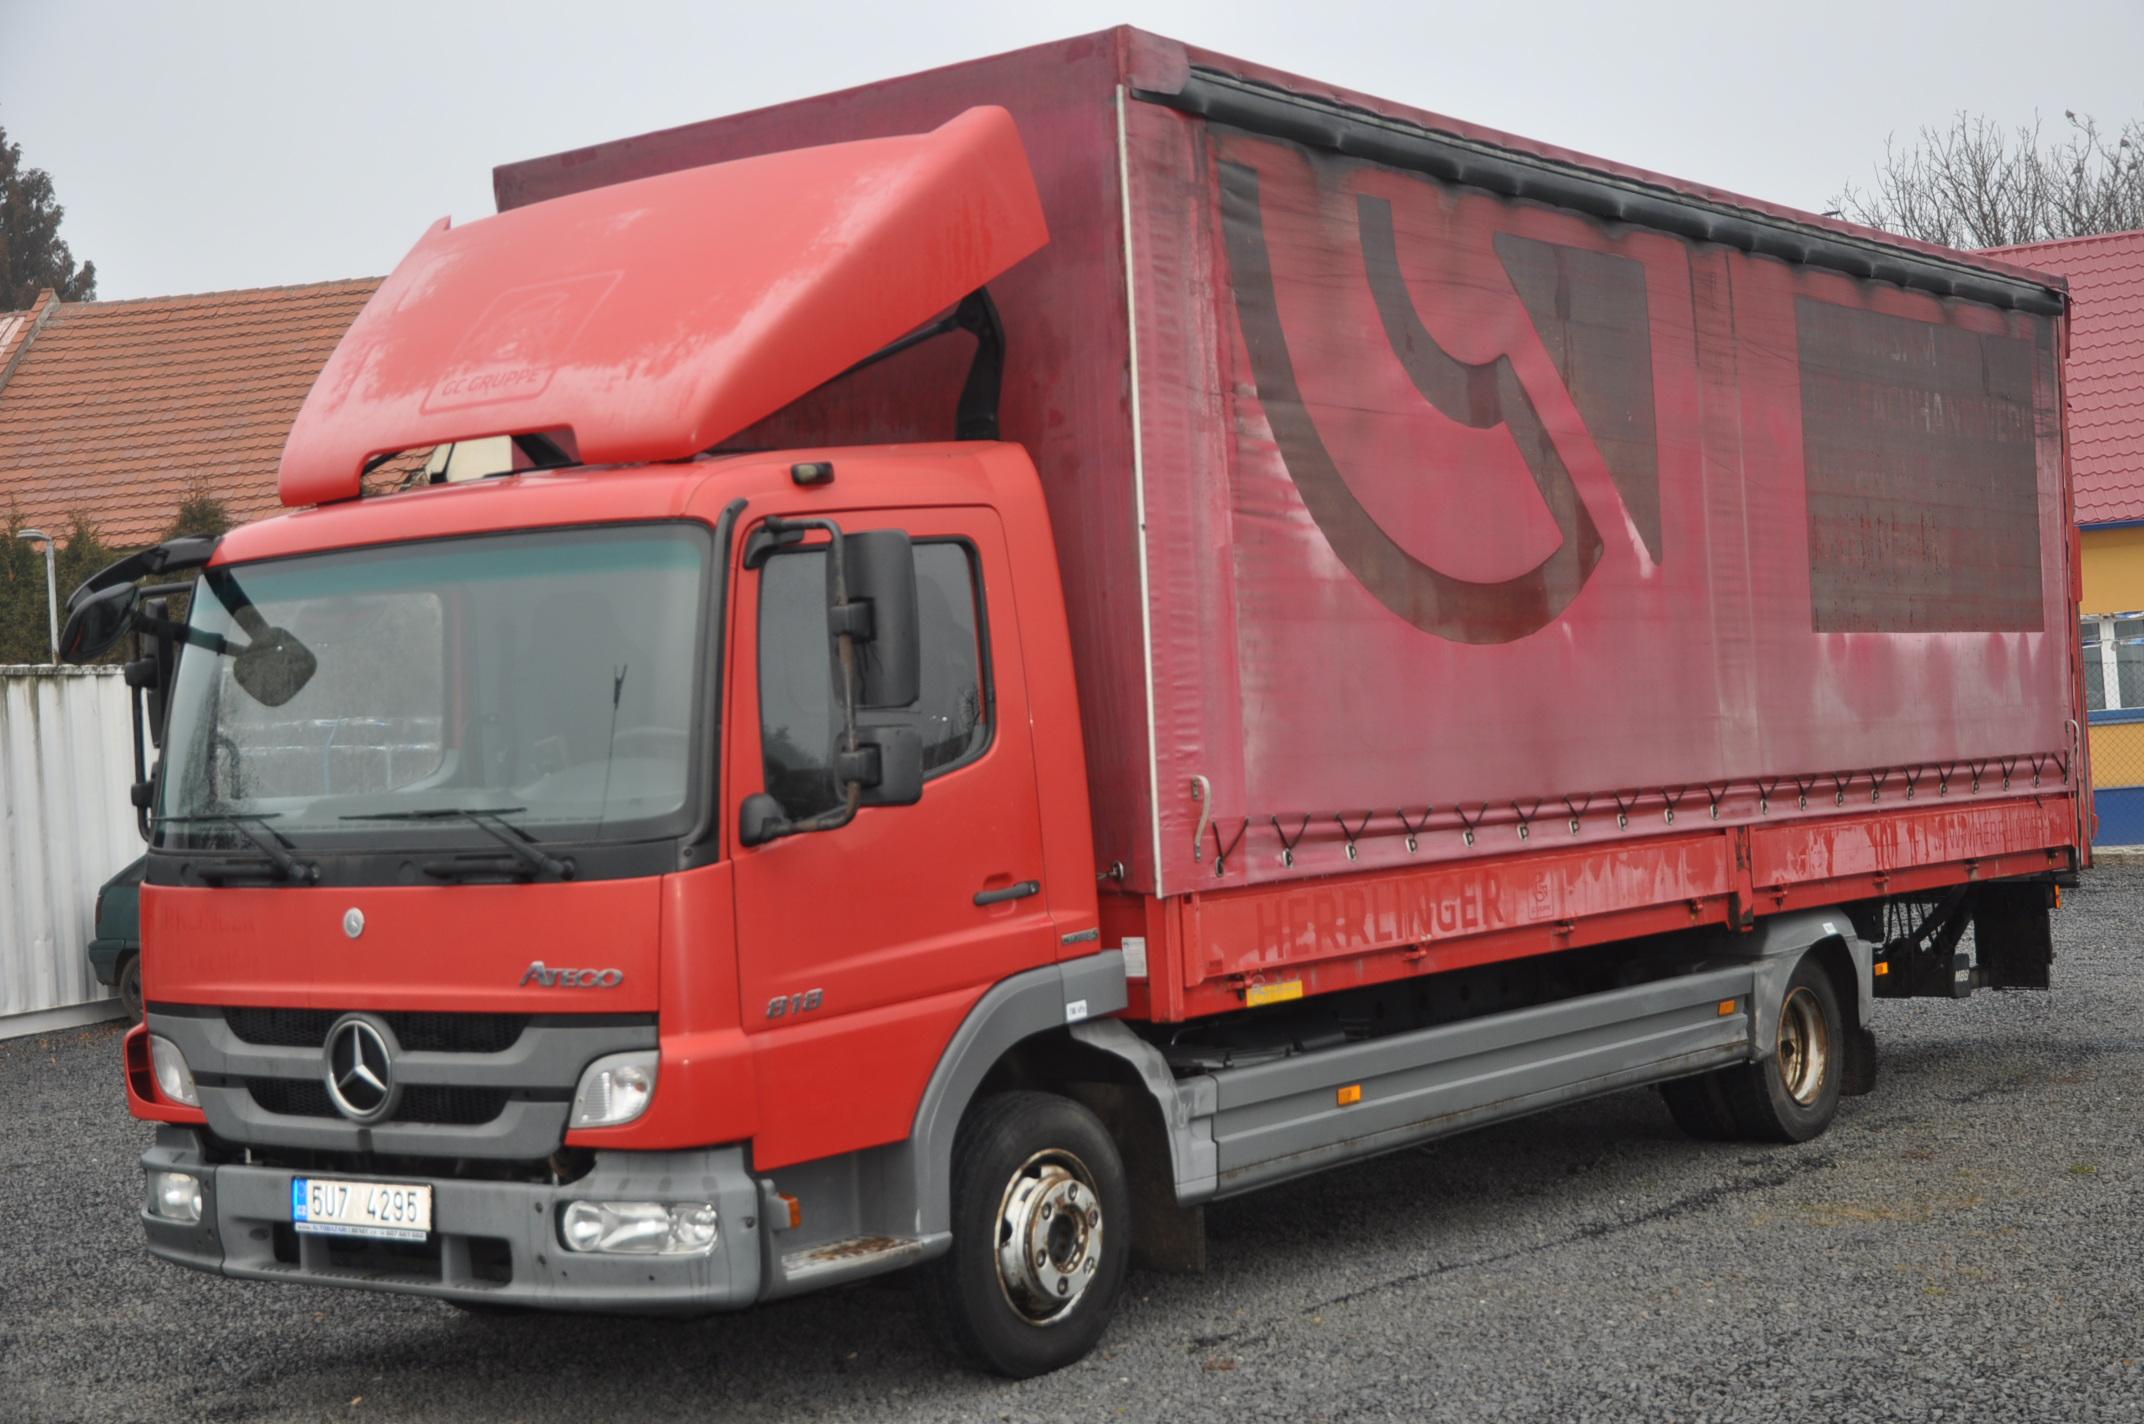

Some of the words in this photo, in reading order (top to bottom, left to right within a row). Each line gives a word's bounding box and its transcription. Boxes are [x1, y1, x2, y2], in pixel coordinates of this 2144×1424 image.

[1256, 871, 1505, 962] HERRLINGER
[765, 988, 823, 1019] 818
[312, 1185, 348, 1218] 5U7
[366, 1187, 417, 1223] 4295
